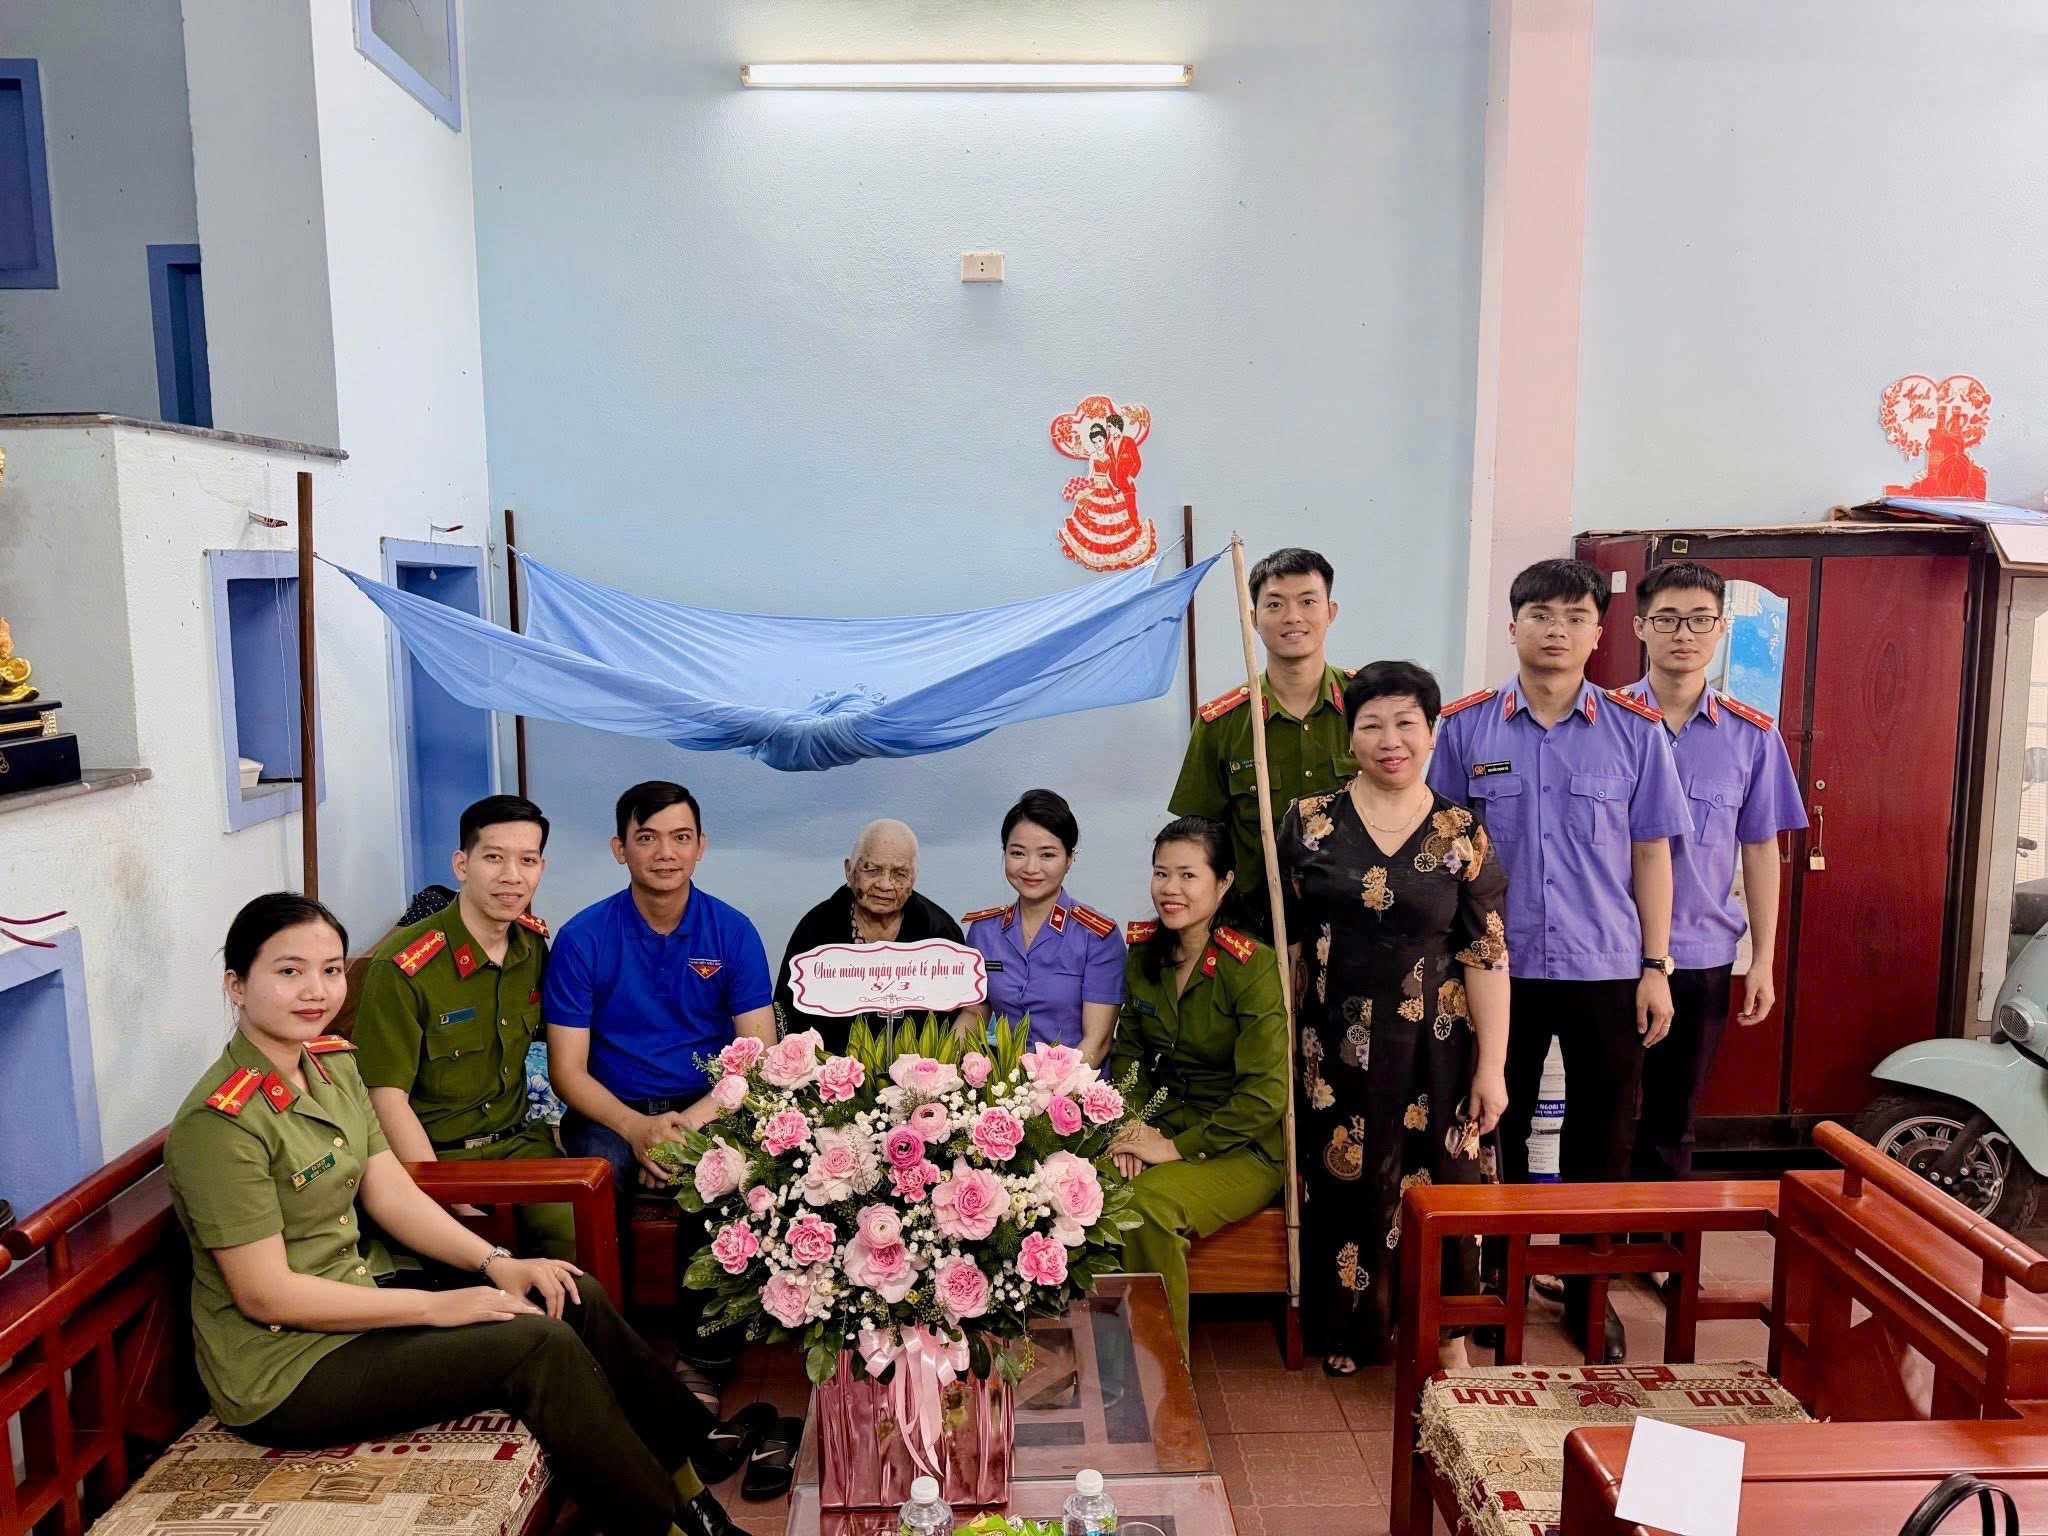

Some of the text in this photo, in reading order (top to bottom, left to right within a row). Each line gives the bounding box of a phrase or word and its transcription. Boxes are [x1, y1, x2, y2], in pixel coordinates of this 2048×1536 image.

[814, 958, 966, 982] Chúc mừng ngày quốc tế phụ nữ
